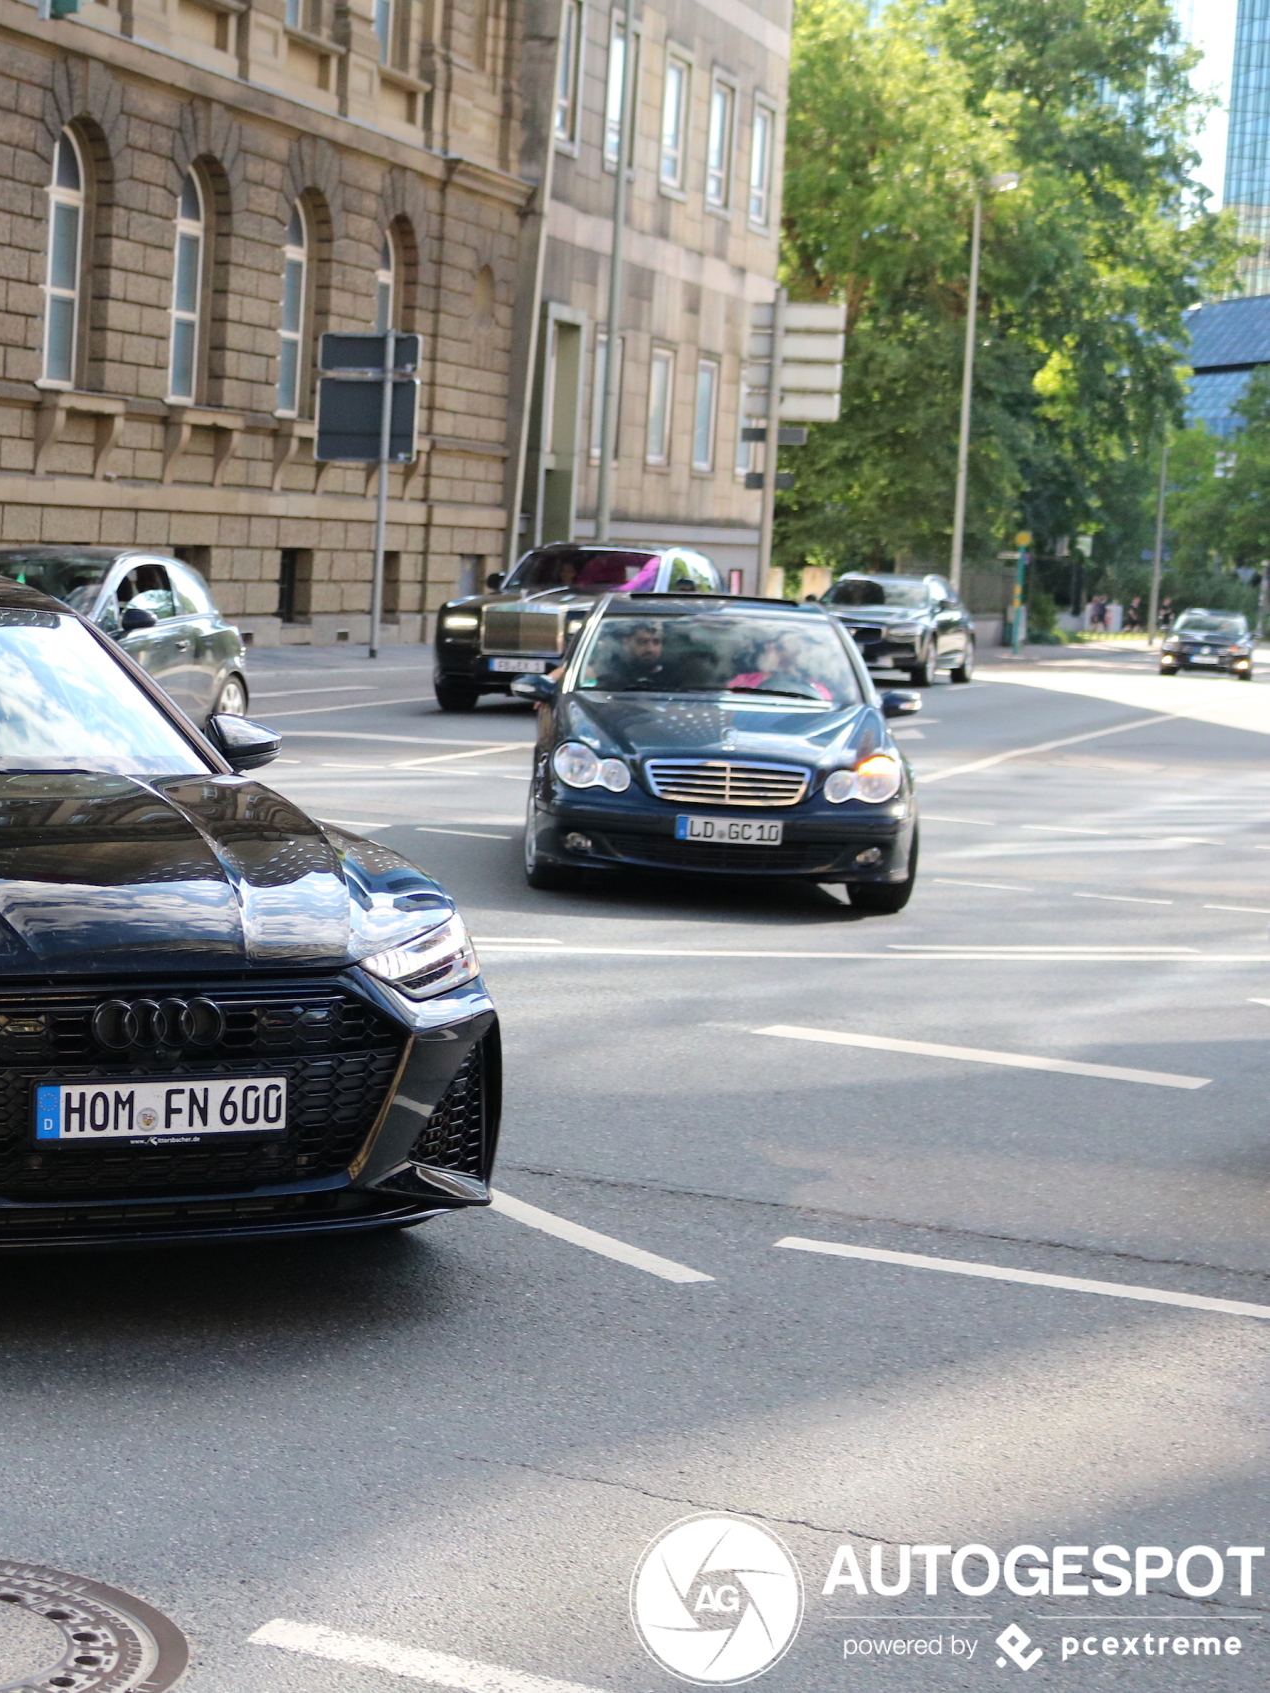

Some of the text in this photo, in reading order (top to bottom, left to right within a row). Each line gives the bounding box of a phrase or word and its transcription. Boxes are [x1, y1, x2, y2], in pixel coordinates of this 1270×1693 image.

[689, 820, 779, 842] LD GC 10
[64, 1084, 283, 1133] HOM FN 600
[43, 1118, 54, 1131] D
